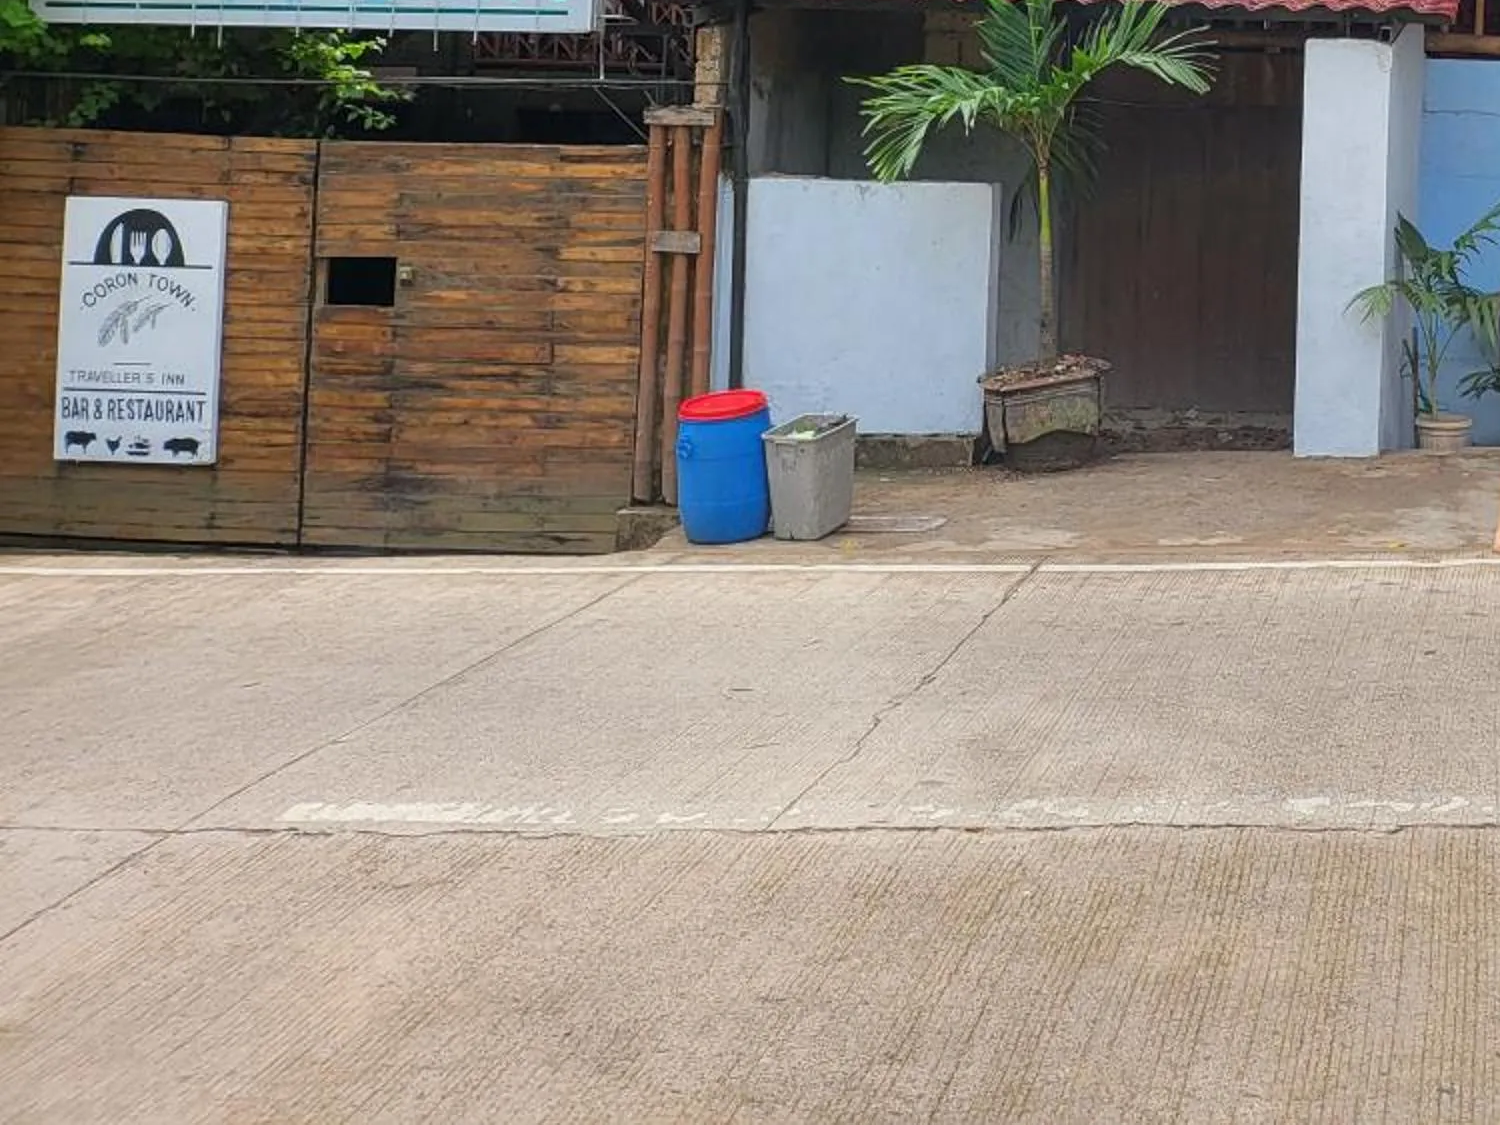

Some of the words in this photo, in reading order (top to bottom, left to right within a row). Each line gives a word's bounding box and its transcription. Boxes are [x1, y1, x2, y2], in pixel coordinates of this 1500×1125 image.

[82, 272, 138, 308] CORON
[148, 273, 196, 308] TOWN
[68, 370, 155, 385] TRAVELLER'S
[161, 374, 186, 386] INN
[61, 396, 89, 420] BAR
[93, 399, 103, 421] &
[107, 399, 207, 424] RESTAURANT
